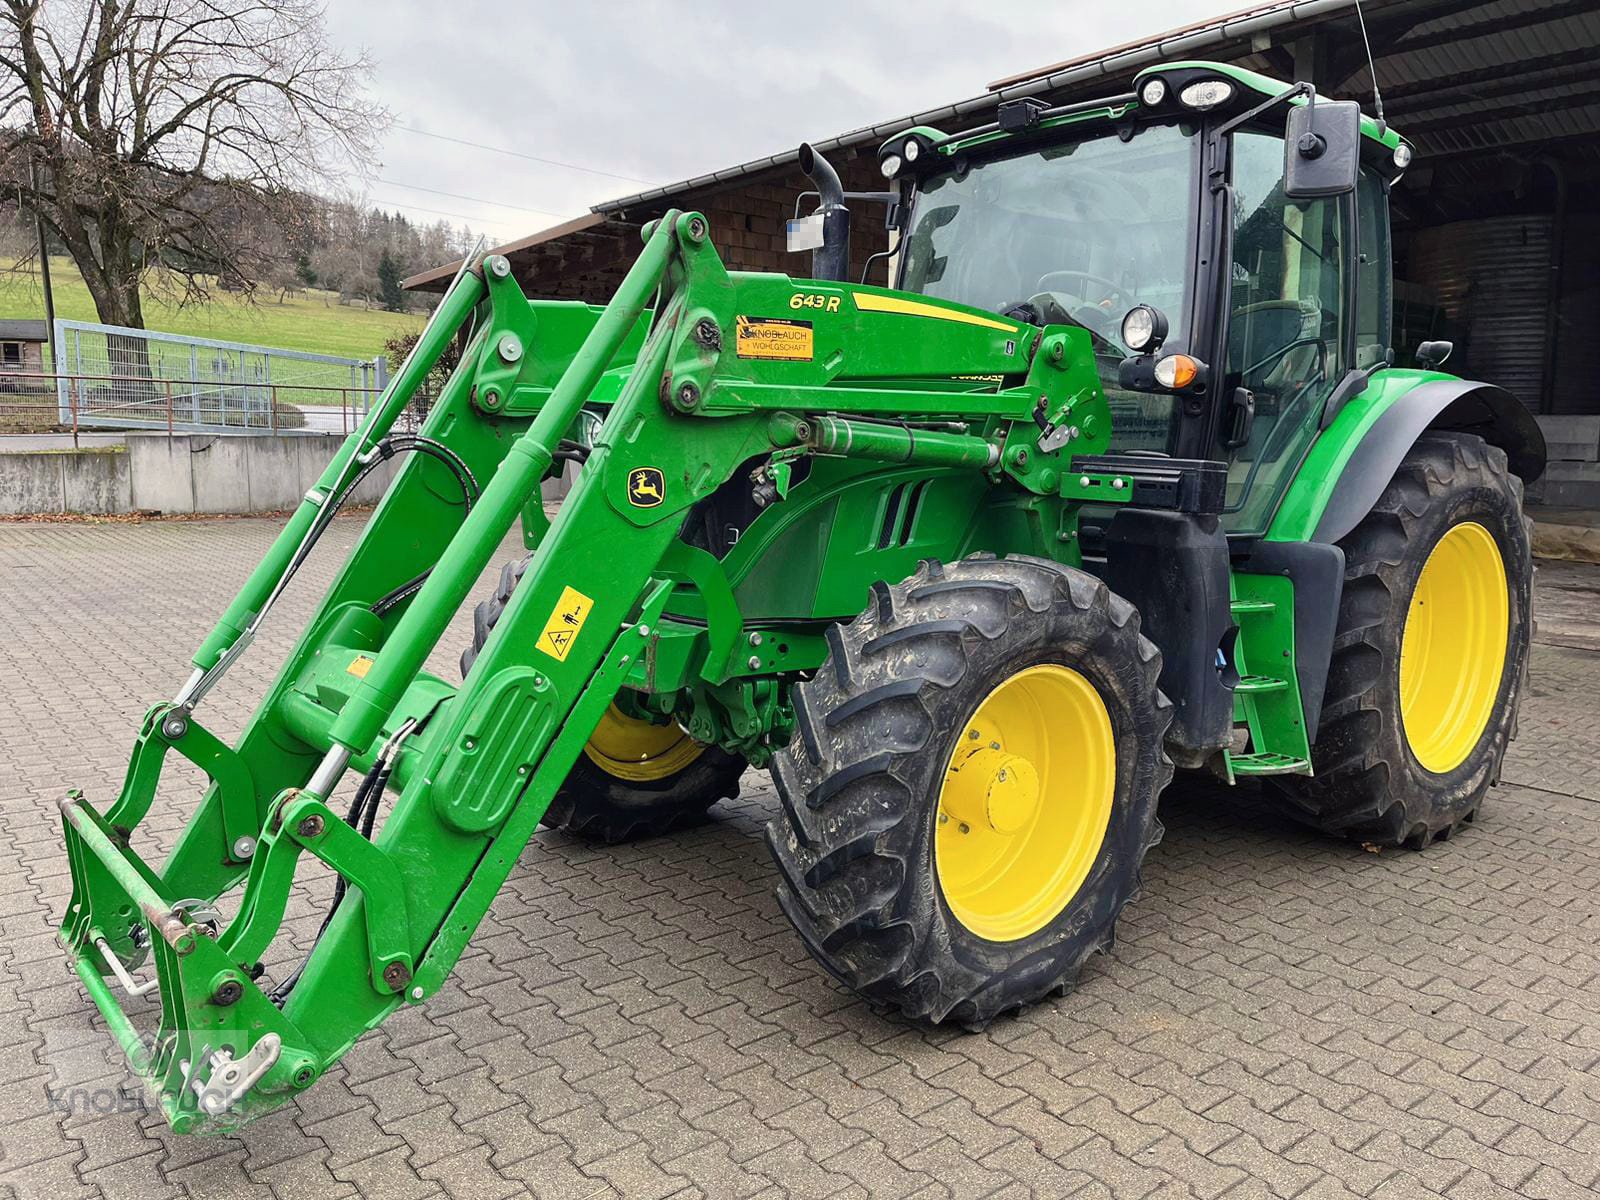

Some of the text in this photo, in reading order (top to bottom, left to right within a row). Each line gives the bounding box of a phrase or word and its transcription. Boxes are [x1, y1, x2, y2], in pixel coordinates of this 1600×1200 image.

[789, 293, 841, 313] 643 R
[751, 329, 807, 340] KNOBLAUCH
